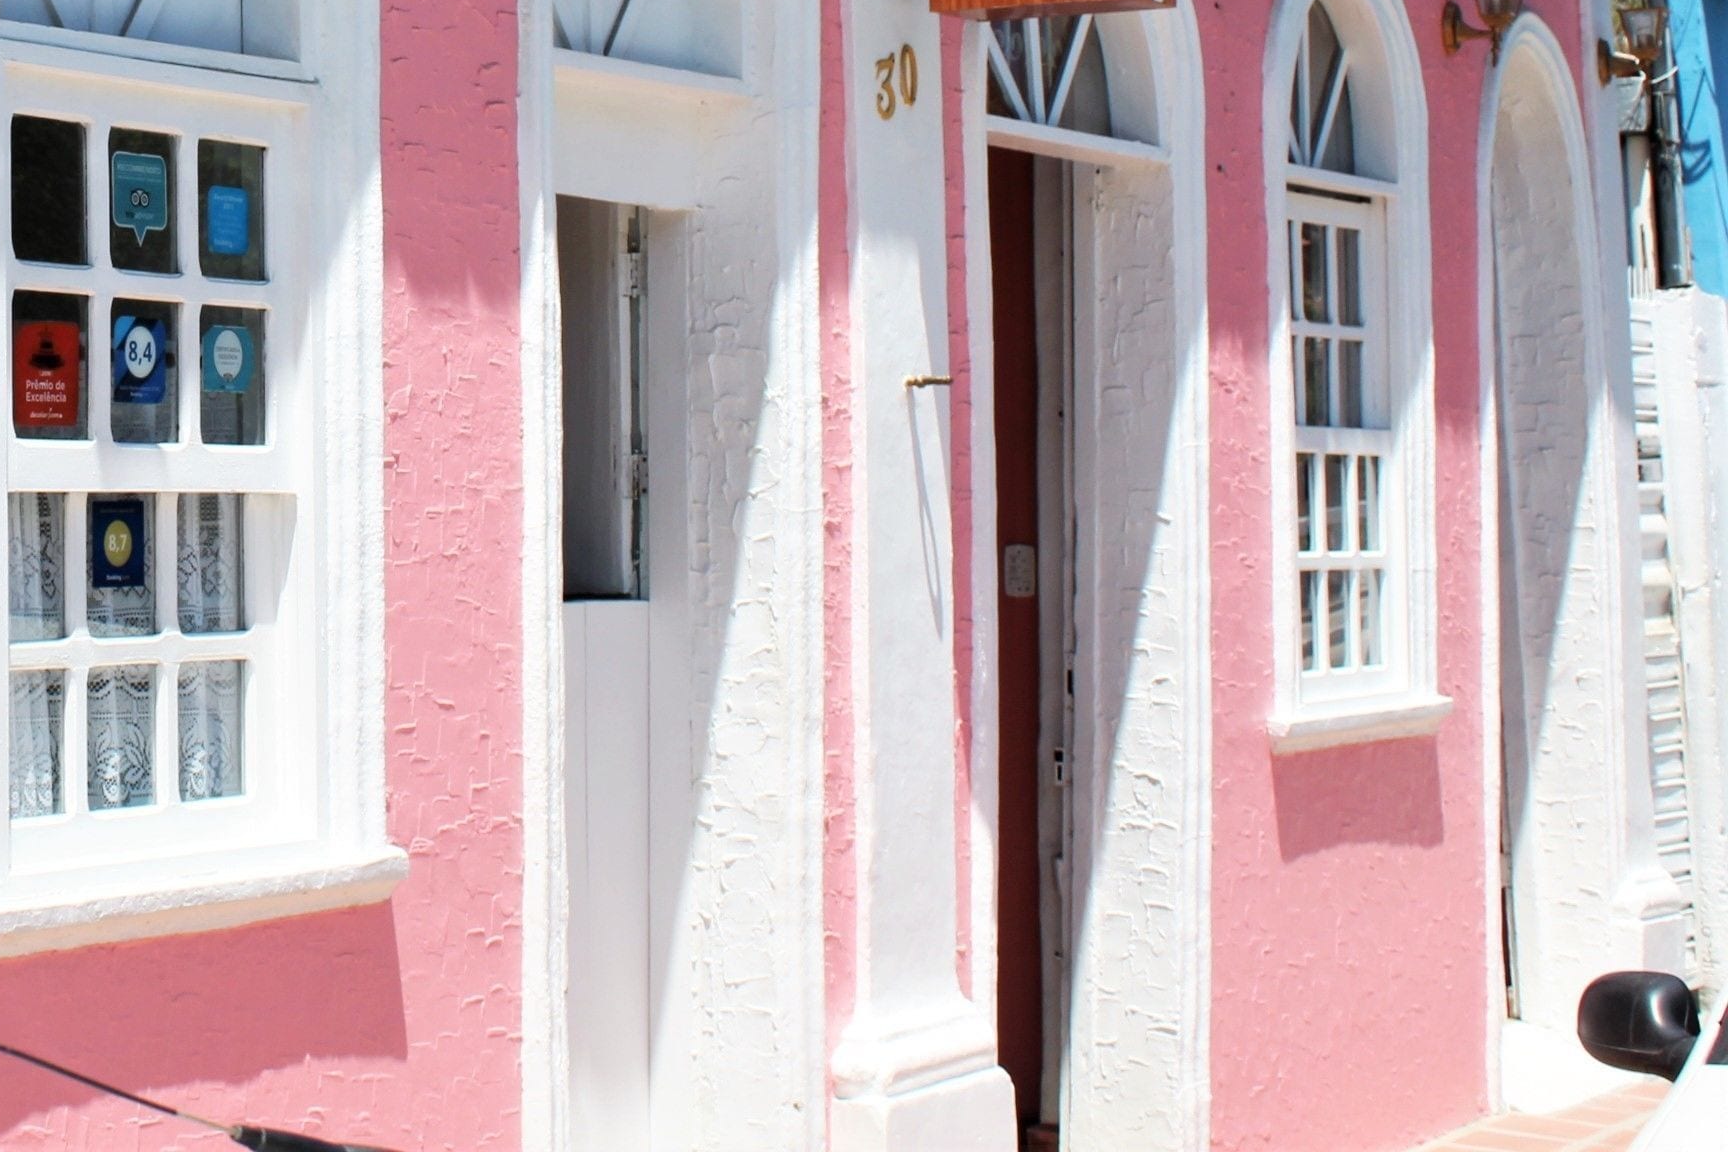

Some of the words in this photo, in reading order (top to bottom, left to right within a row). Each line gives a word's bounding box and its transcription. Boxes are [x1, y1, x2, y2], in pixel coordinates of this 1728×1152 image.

[875, 43, 919, 121] 30
[128, 340, 153, 366] 8,4
[55, 379, 66, 390] de
[109, 533, 128, 553] 8,7
